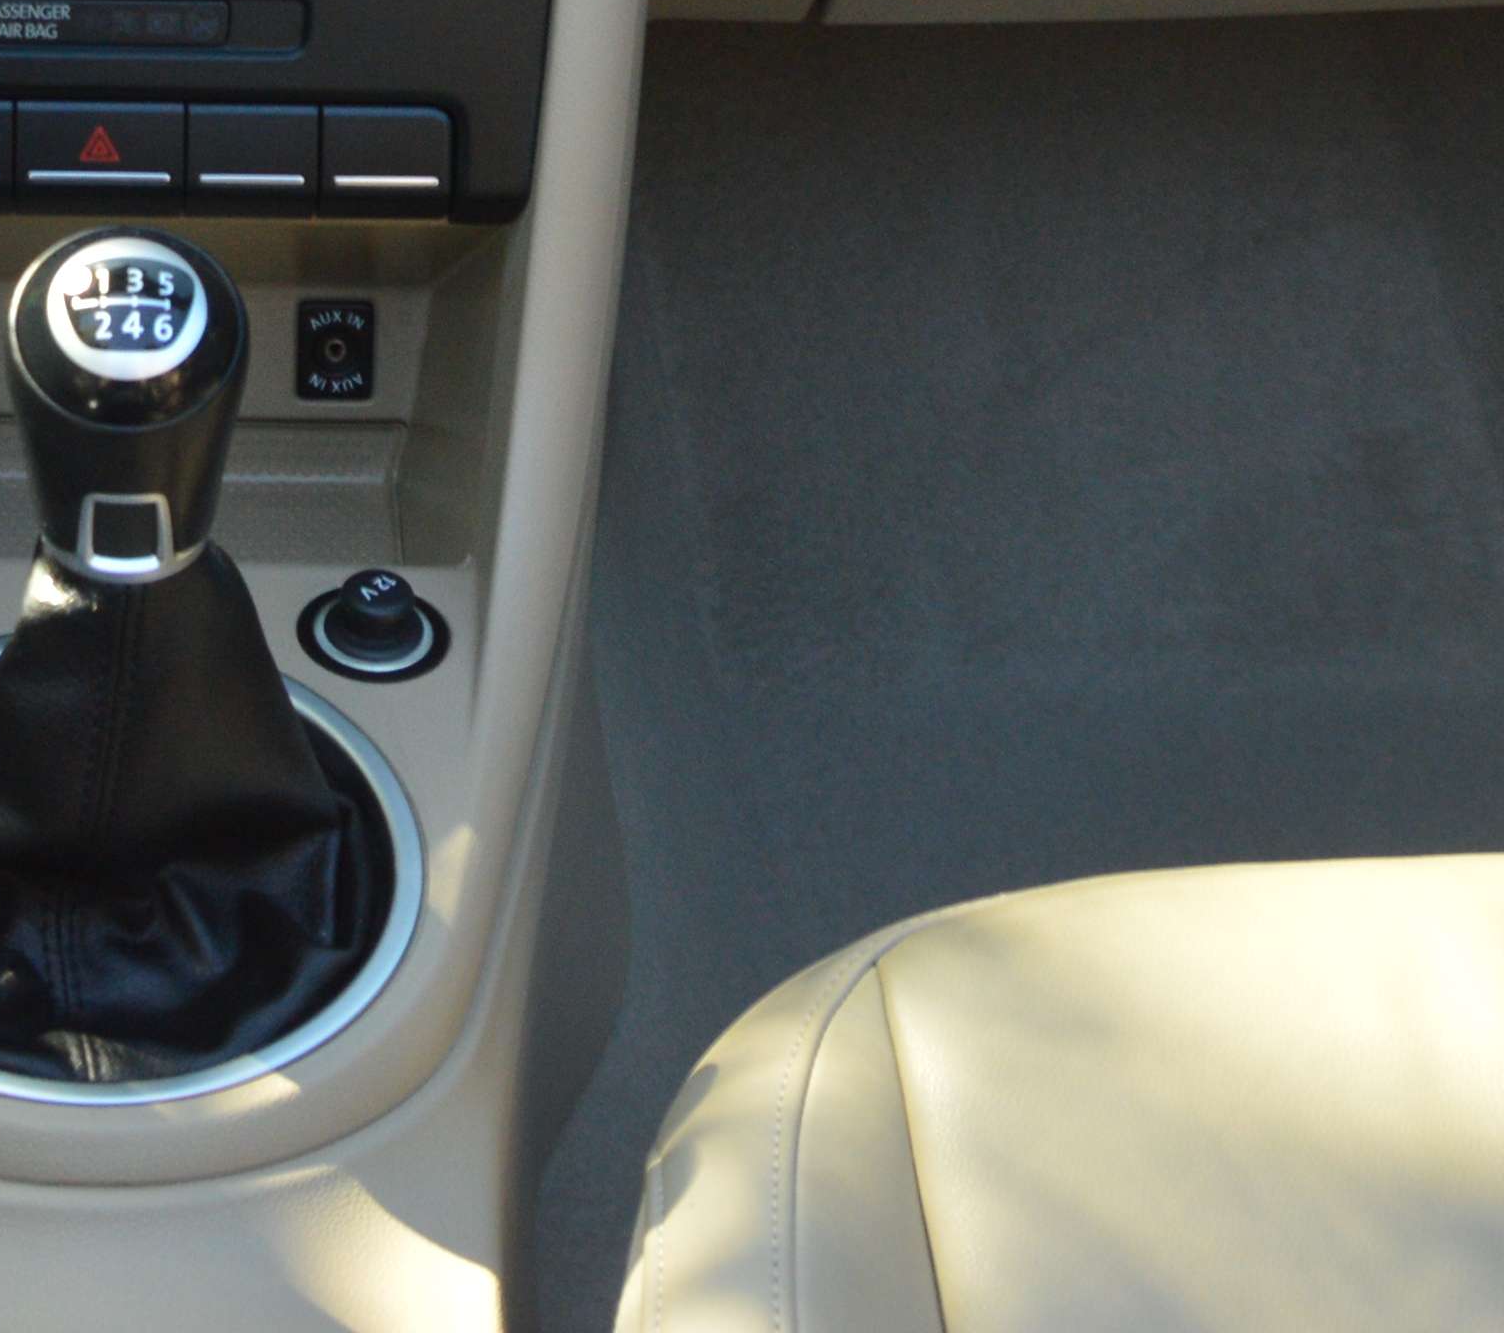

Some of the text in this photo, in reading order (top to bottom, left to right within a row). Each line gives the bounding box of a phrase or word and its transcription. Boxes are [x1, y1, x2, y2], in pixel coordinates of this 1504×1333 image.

[25, 24, 58, 39] BAG
[95, 267, 174, 296] 1 3 5
[94, 310, 173, 343] 2 4 6
[311, 309, 365, 331] AUX IN
[332, 373, 363, 393] AUX
